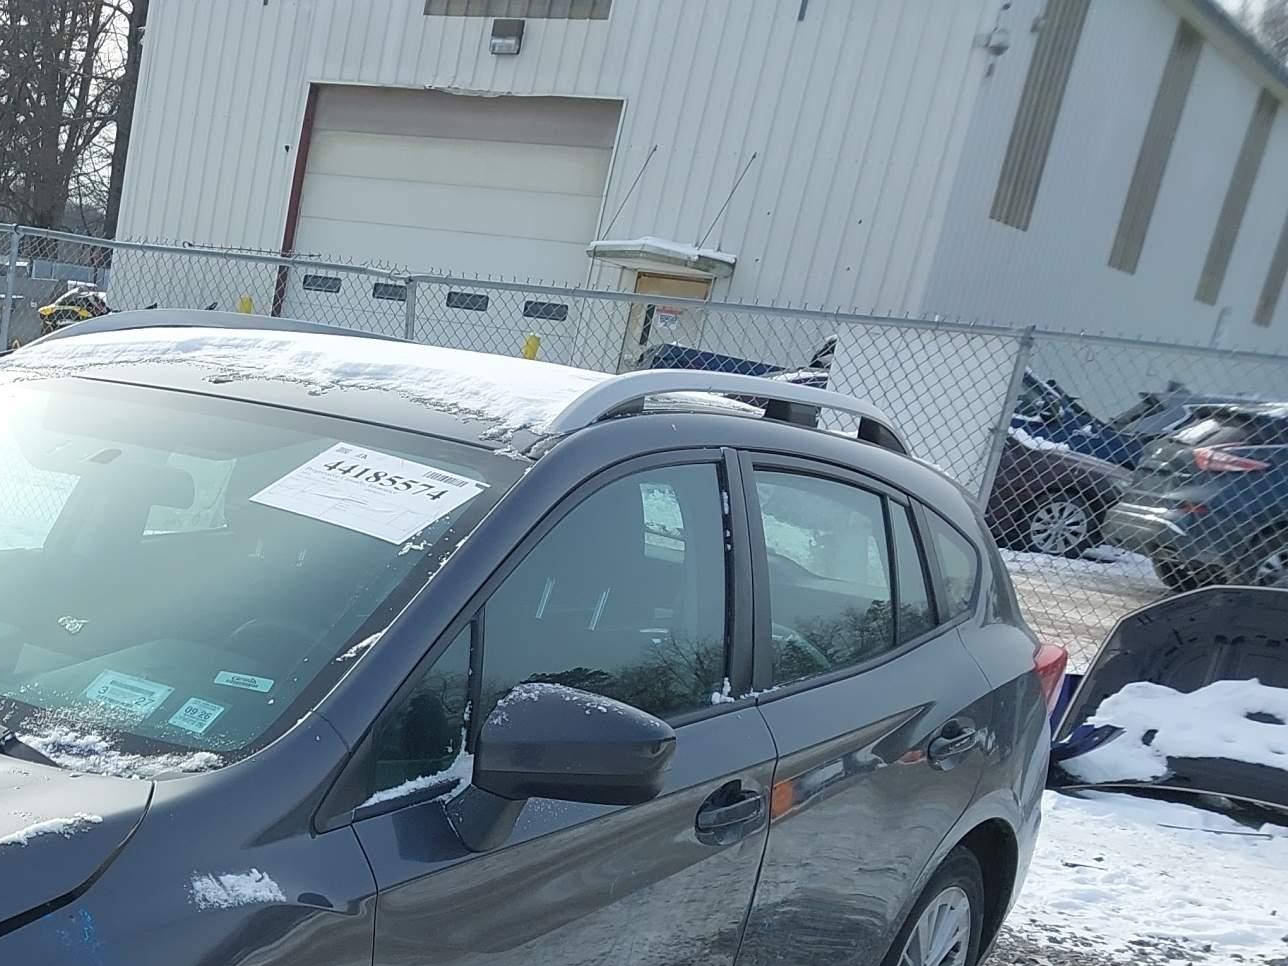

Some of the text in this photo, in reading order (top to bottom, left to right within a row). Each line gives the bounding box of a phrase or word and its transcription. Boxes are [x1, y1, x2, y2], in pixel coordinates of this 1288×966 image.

[323, 460, 449, 501] 44185574
[134, 696, 156, 706] 27
[184, 706, 199, 716] 09
[198, 710, 213, 720] 26
